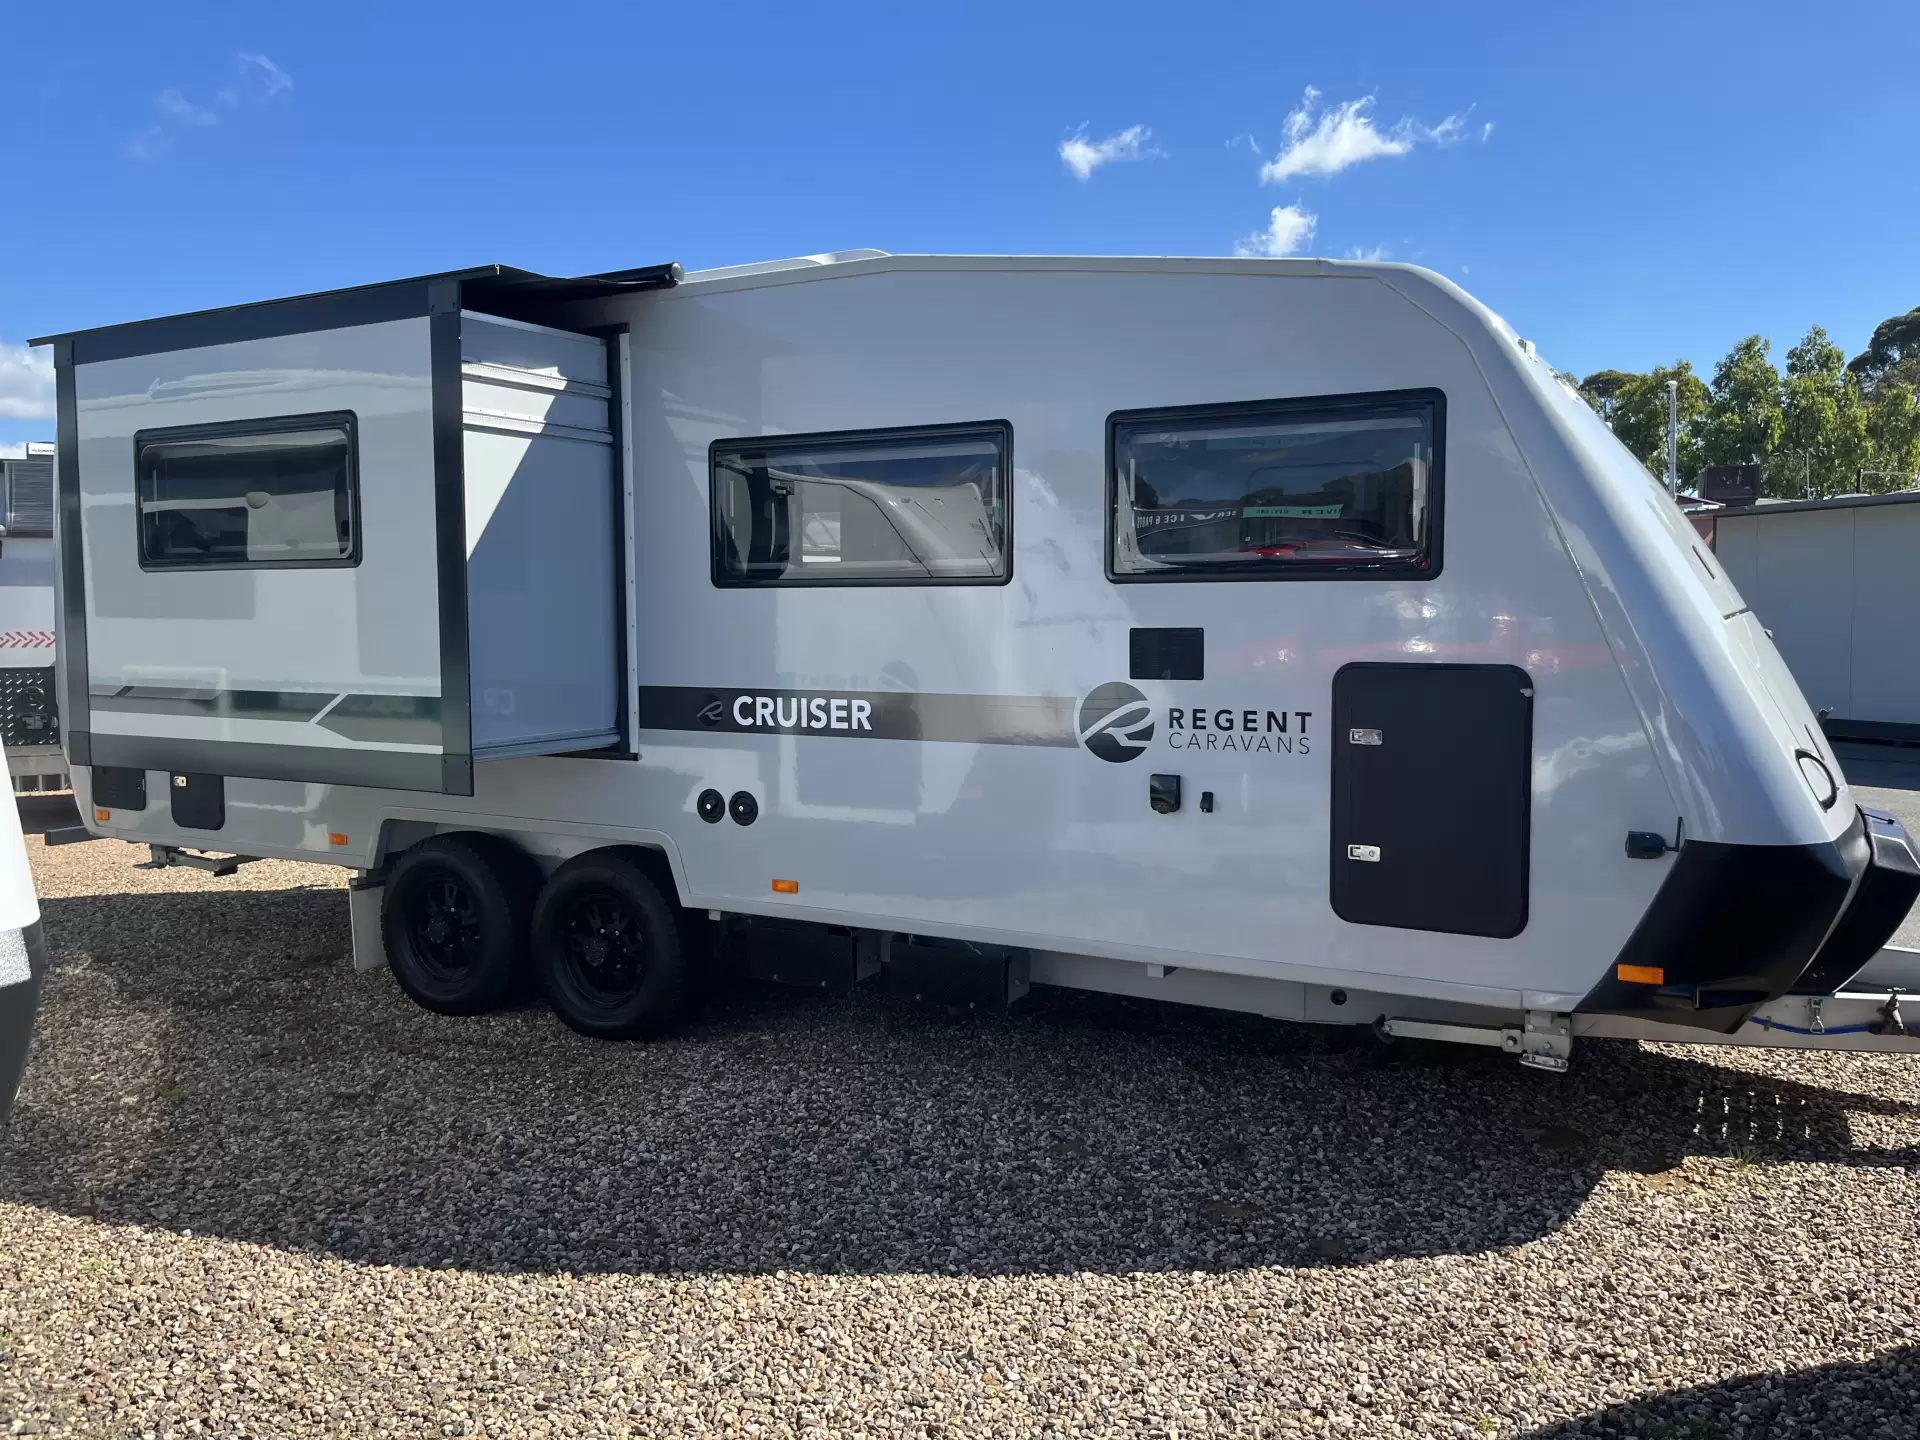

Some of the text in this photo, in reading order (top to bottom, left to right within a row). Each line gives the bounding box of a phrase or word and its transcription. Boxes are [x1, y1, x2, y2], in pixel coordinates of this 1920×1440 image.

[732, 695, 873, 730] CRUISER
[1168, 708, 1312, 733] REGENT
[1168, 731, 1311, 755] CARAVANS
